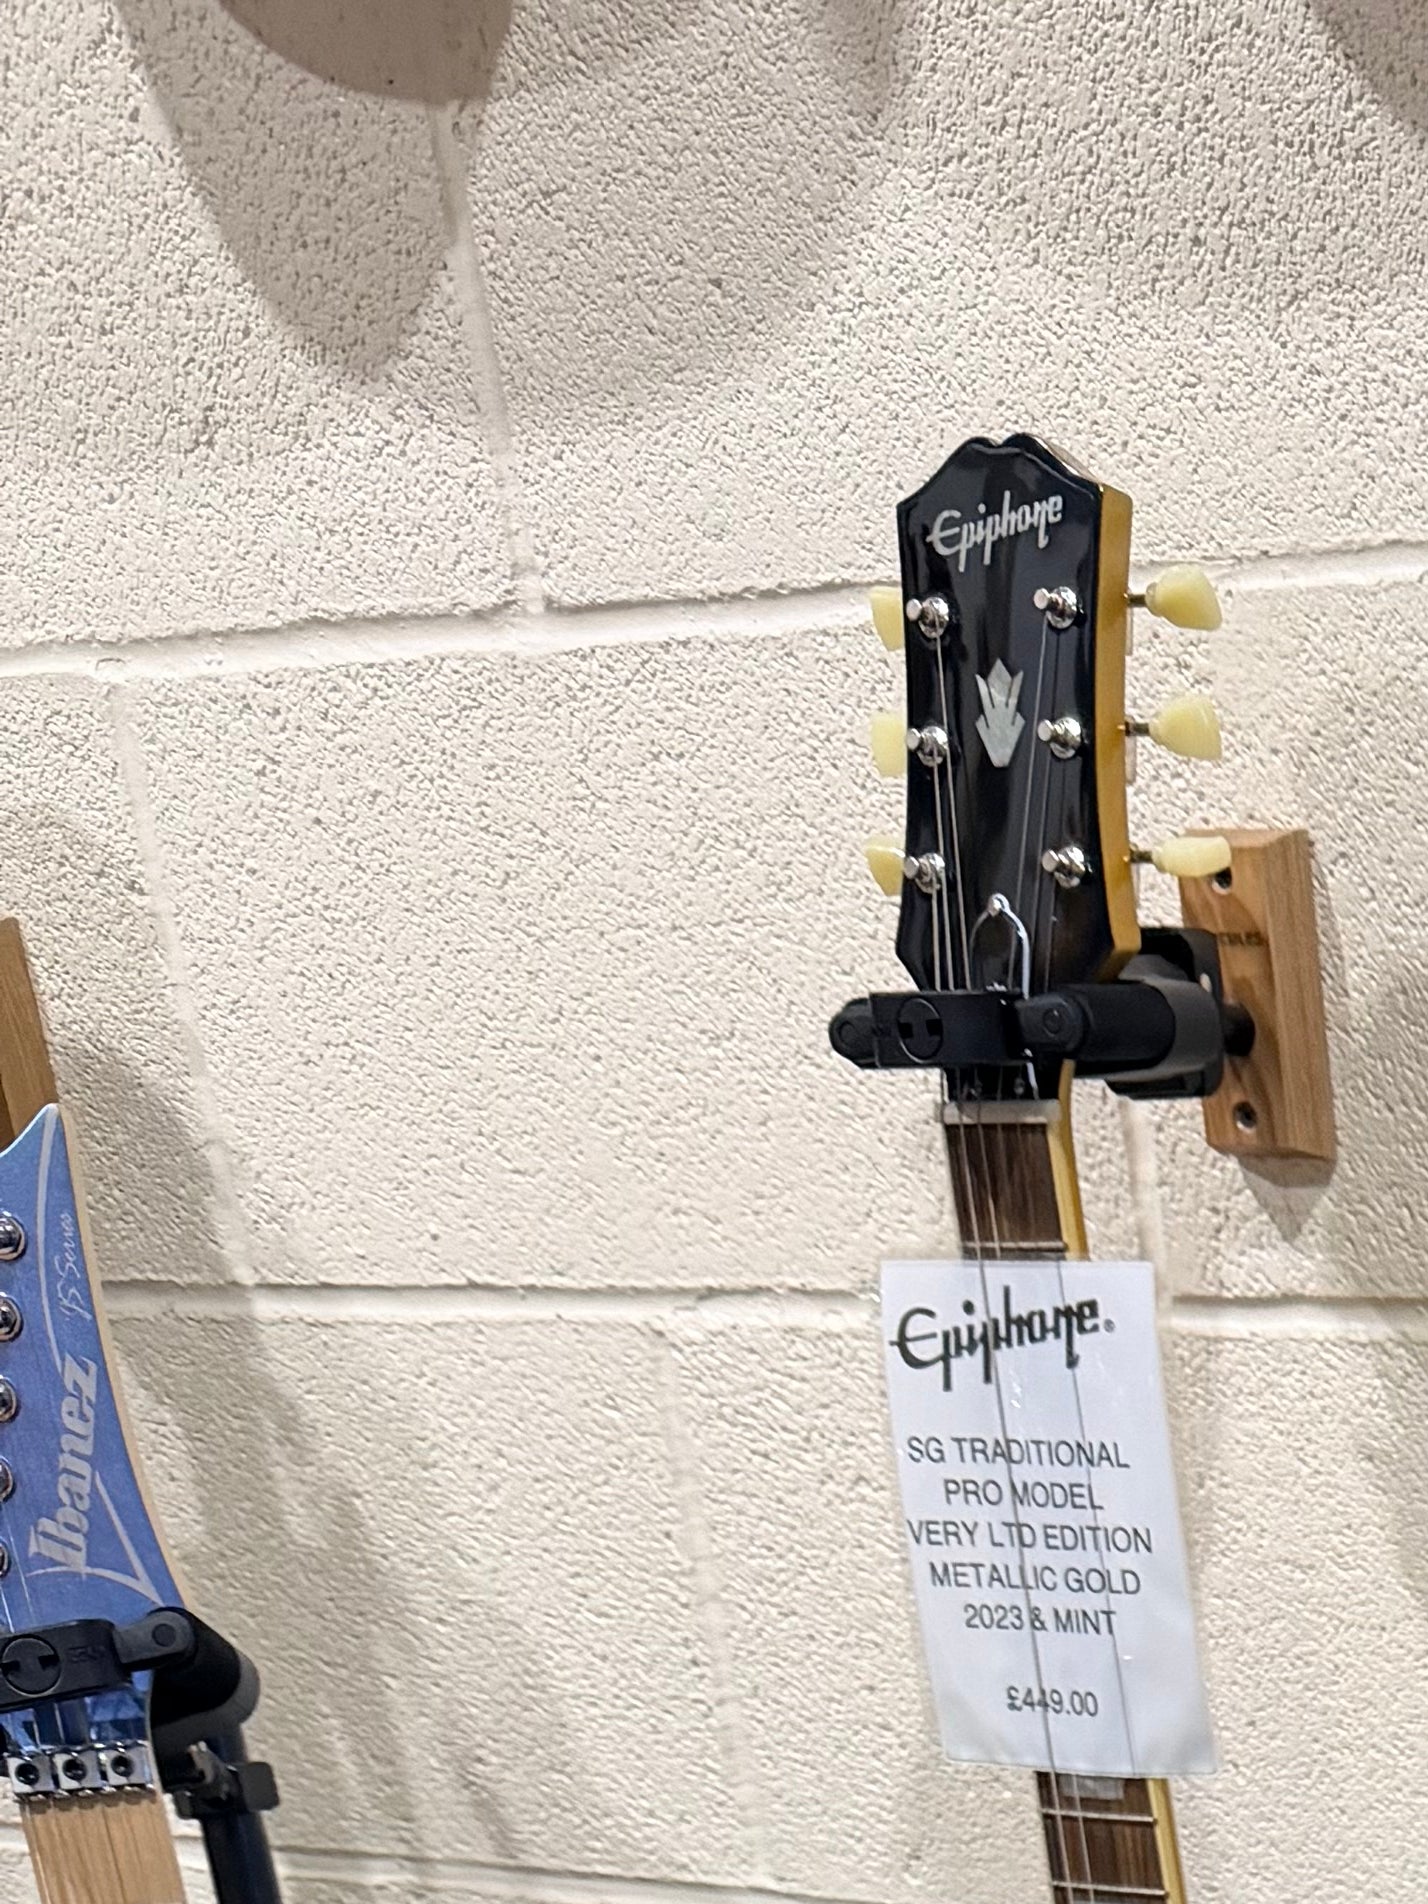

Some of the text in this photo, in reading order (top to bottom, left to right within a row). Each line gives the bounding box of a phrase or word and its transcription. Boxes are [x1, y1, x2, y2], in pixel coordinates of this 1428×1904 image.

[925, 490, 1064, 573] Epiphone
[889, 1286, 1099, 1391] Epiphone
[29, 1352, 98, 1580] Ibanez
[908, 1437, 1130, 1469] SG TRADITIONAL
[945, 1479, 1104, 1511] PRO MODEL
[908, 1520, 1153, 1554] VERY LTD EDITION
[930, 1562, 1141, 1595] METALLIC GOLD
[964, 1604, 1117, 1636] 2023 & MINT
[1006, 1687, 1099, 1717] £449.00
